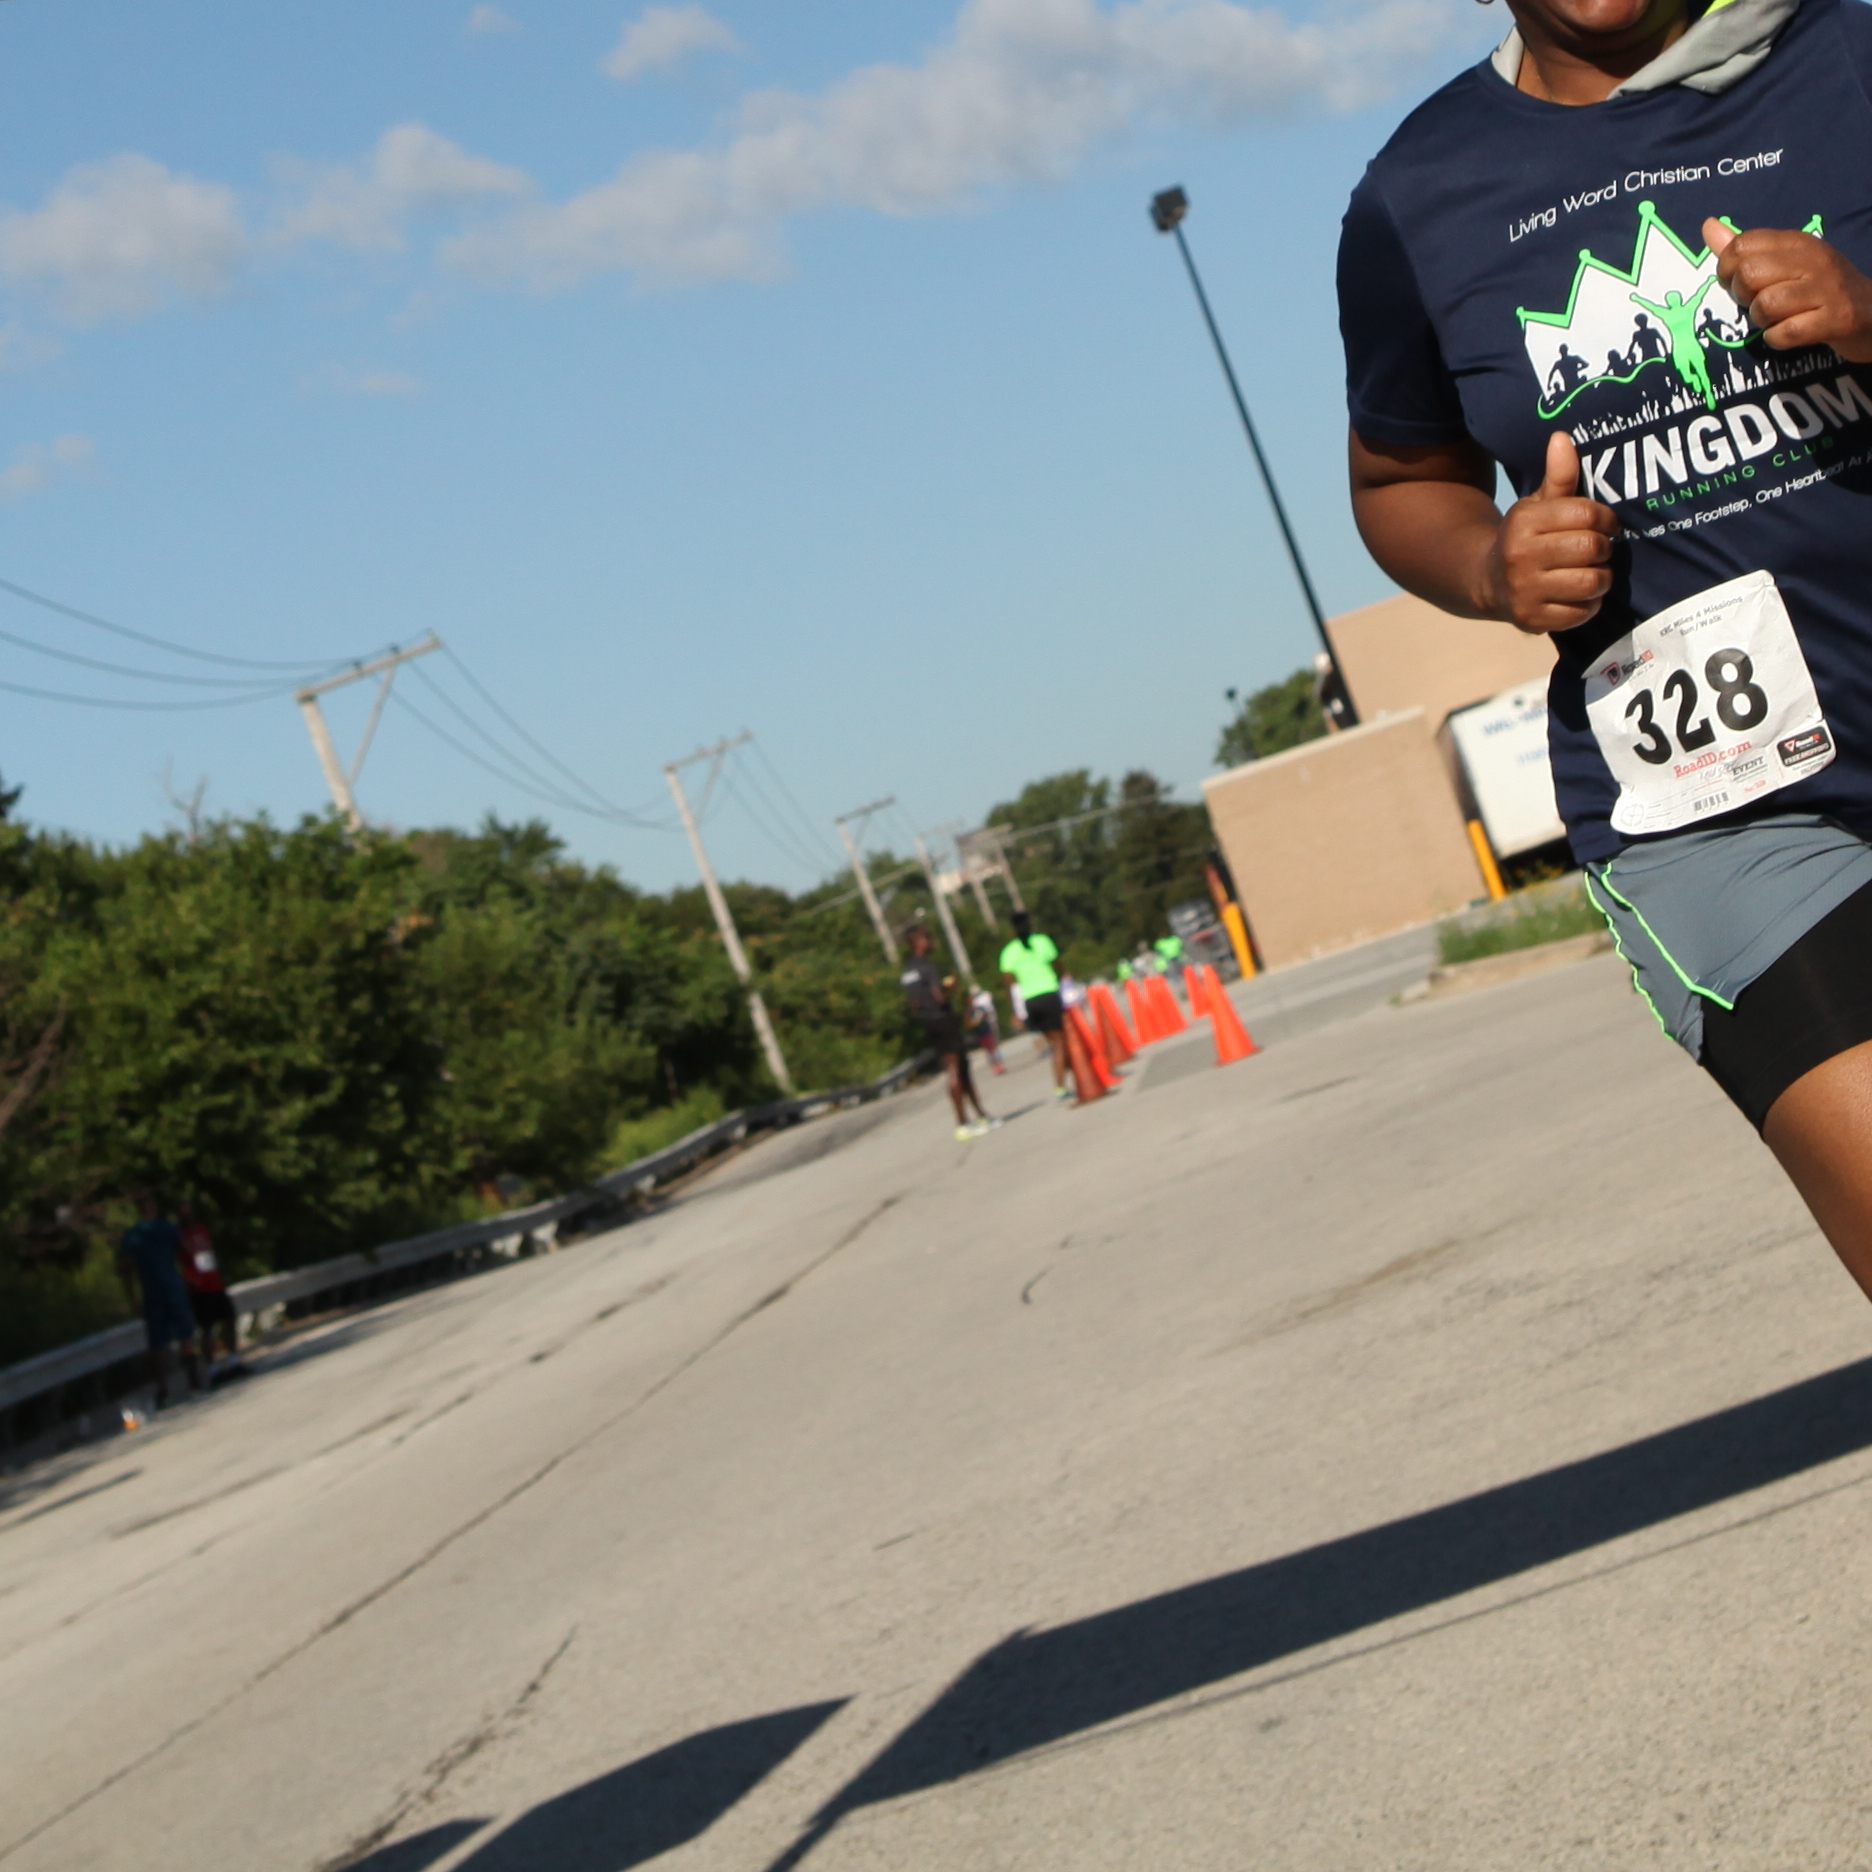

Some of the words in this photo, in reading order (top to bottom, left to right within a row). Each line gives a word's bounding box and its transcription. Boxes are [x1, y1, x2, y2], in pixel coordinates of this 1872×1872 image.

[1509, 207, 1556, 242] Living
[1563, 180, 1617, 213] Word
[1624, 166, 1710, 192] Christian
[1717, 149, 1784, 175] Center
[1646, 466, 1755, 511] RUNNING
[1773, 437, 1835, 467] CLUB
[1668, 517, 1693, 532] One
[1695, 498, 1752, 525] Footstep,
[1756, 486, 1782, 503] One
[1624, 647, 1768, 765] 328
[1673, 740, 1753, 778] RoadID.com
[1732, 756, 1766, 776] EVENT
